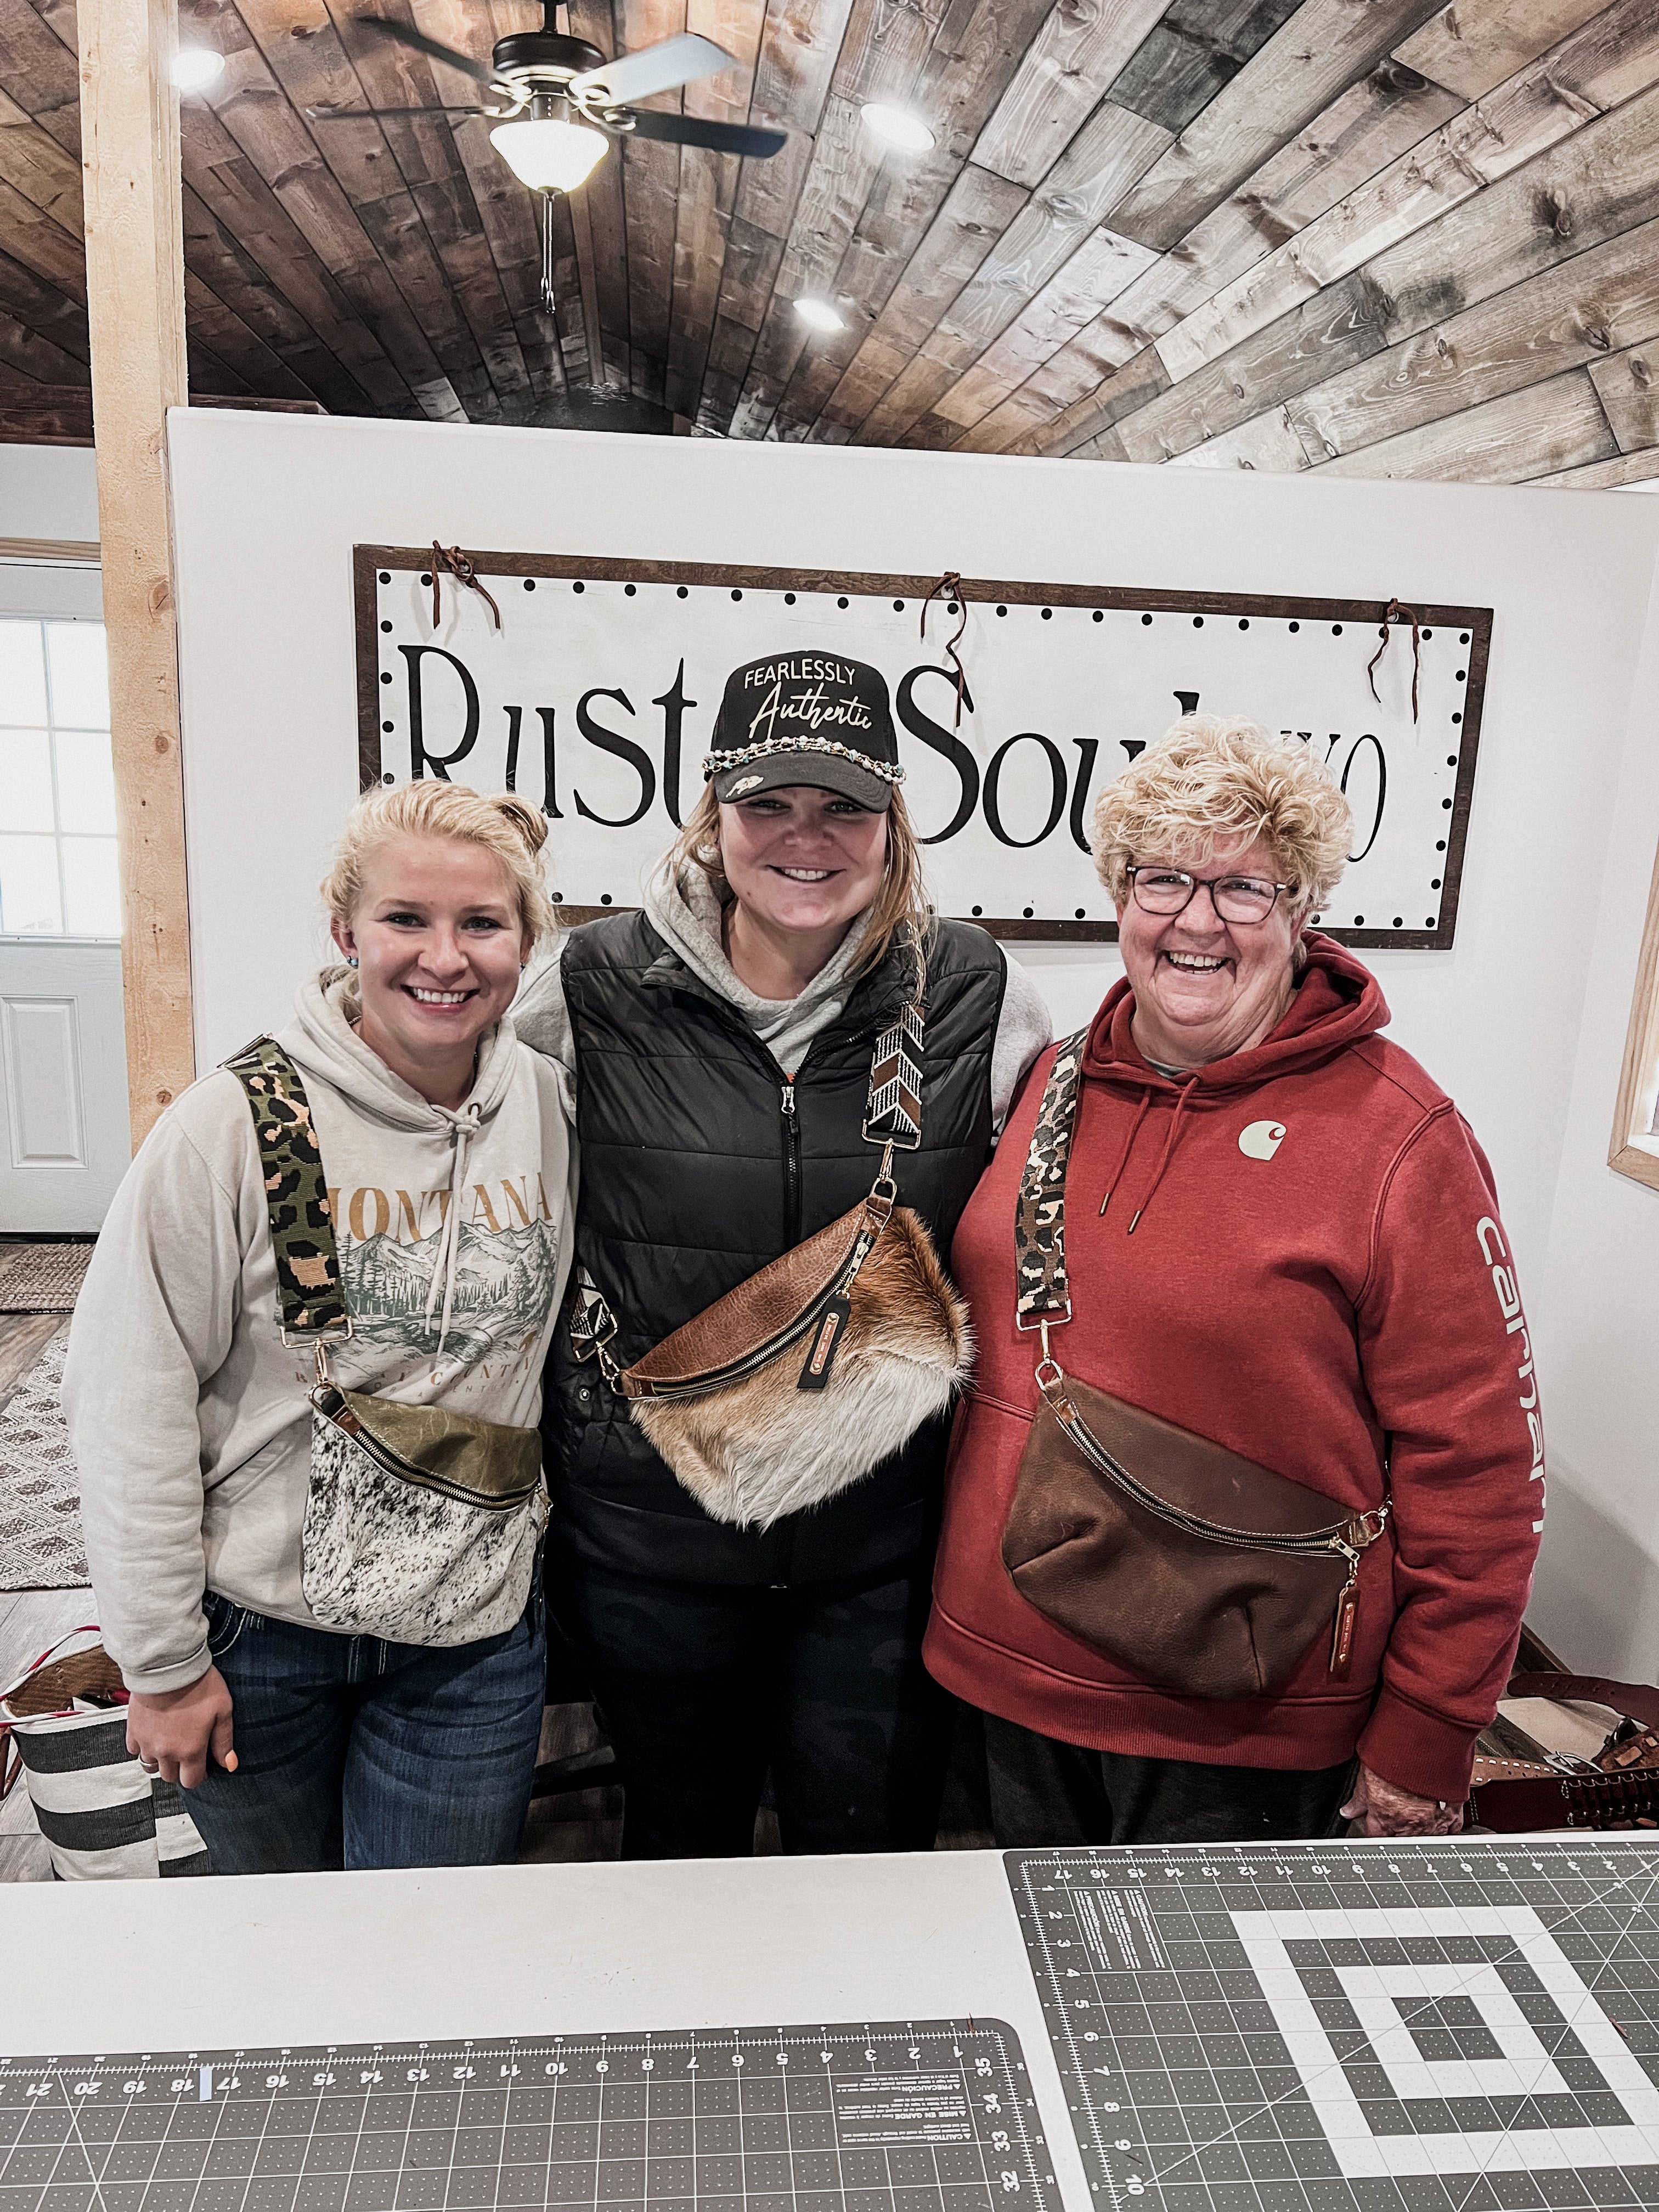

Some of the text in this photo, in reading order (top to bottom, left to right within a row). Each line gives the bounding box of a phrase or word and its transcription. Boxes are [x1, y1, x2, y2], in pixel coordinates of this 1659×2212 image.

[744, 658, 855, 690] FEARLESSLY
[748, 681, 873, 740] Authentic
[398, 645, 697, 832] Rust
[896, 664, 1200, 856] Sou
[1311, 1865, 1332, 1875] 10
[1352, 1864, 1365, 1874] 9
[1388, 1864, 1401, 1874] 8
[1427, 1863, 1438, 1873] 7
[1460, 1863, 1474, 1872] 6
[1496, 1862, 1509, 1872] 5
[1567, 1861, 1581, 1871] 3
[1602, 1860, 1617, 1870] 2
[1054, 1870, 1073, 1880] 17
[1090, 1869, 1110, 1879] 16
[1127, 1868, 1148, 1878] 15
[1164, 1867, 1186, 1878] 14
[1201, 1866, 1222, 1877] 13
[1237, 1866, 1259, 1876] 12
[1274, 1865, 1294, 1876] 11
[1048, 1911, 1063, 1920] 2
[1057, 1939, 1071, 1948] 3
[1066, 1968, 1081, 1977] 4
[1074, 2000, 1090, 2009] 5
[1084, 2032, 1099, 2041] 6
[1093, 2066, 1111, 2076] 7
[1103, 2102, 1120, 2113] 8
[1114, 2139, 1132, 2151] 9
[1125, 2174, 1145, 2195] 10
[25, 2045, 964, 2097] 1 2 3 4 5 6 7 8 9 10 11 12 13 14 15 16 17 18 19 20 21
[974, 2057, 1021, 2193] 35 34 33 32
